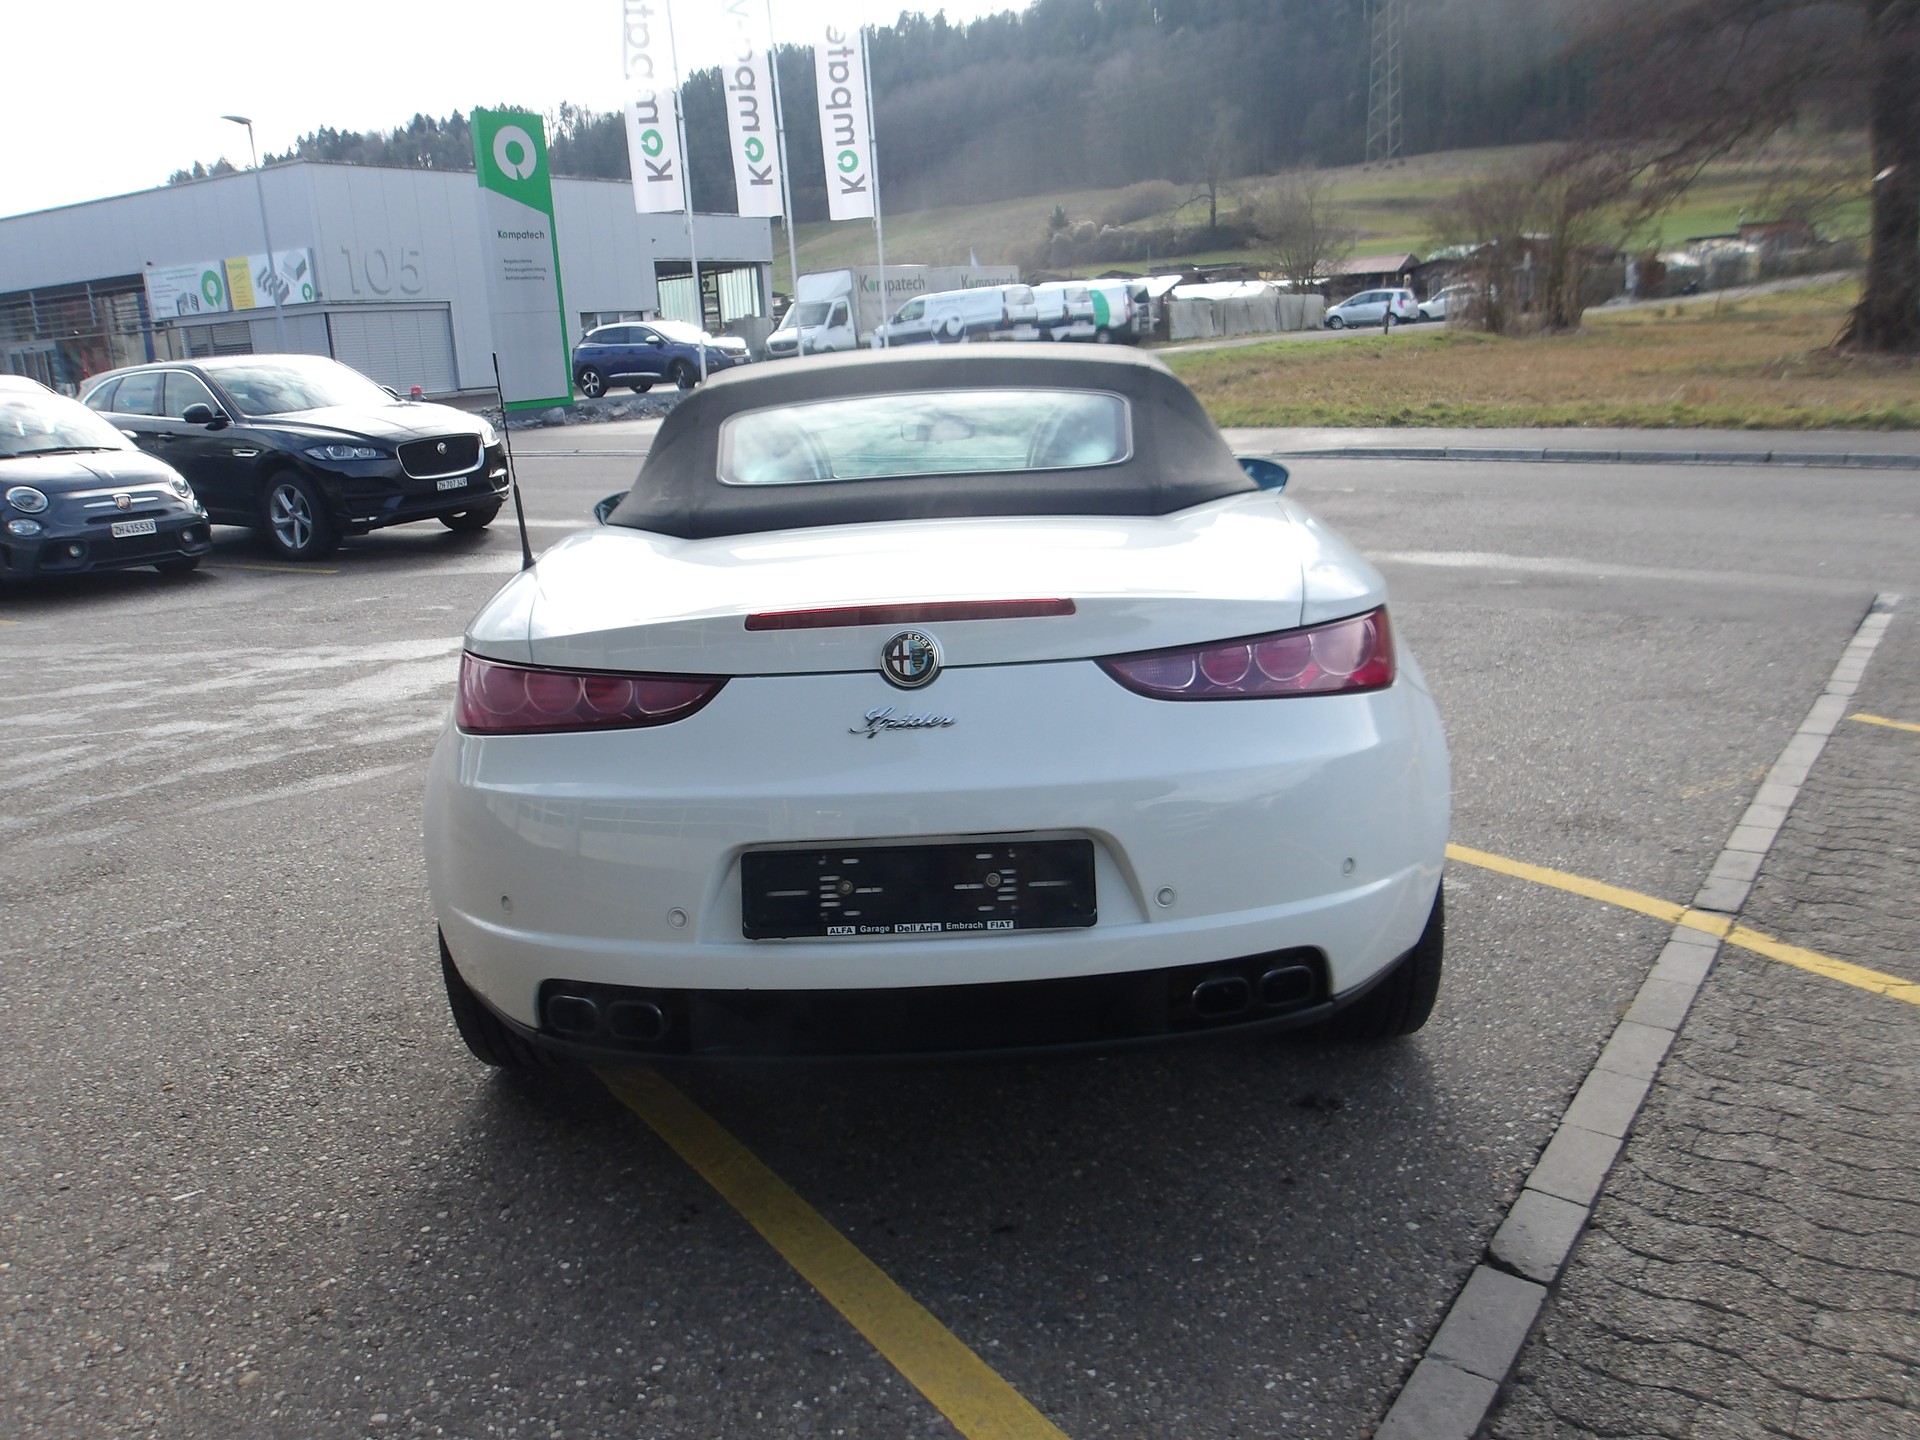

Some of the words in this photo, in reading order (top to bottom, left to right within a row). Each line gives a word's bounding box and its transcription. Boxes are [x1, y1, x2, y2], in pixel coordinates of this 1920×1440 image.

[497, 230, 545, 241] Kompatech
[341, 245, 423, 295] 105
[907, 633, 934, 657] ROMEO
[848, 705, 957, 739] Spider
[829, 926, 853, 935] ALFA
[860, 925, 890, 934] Garage
[946, 921, 983, 930] Embrach
[990, 920, 1012, 929] FIAT
